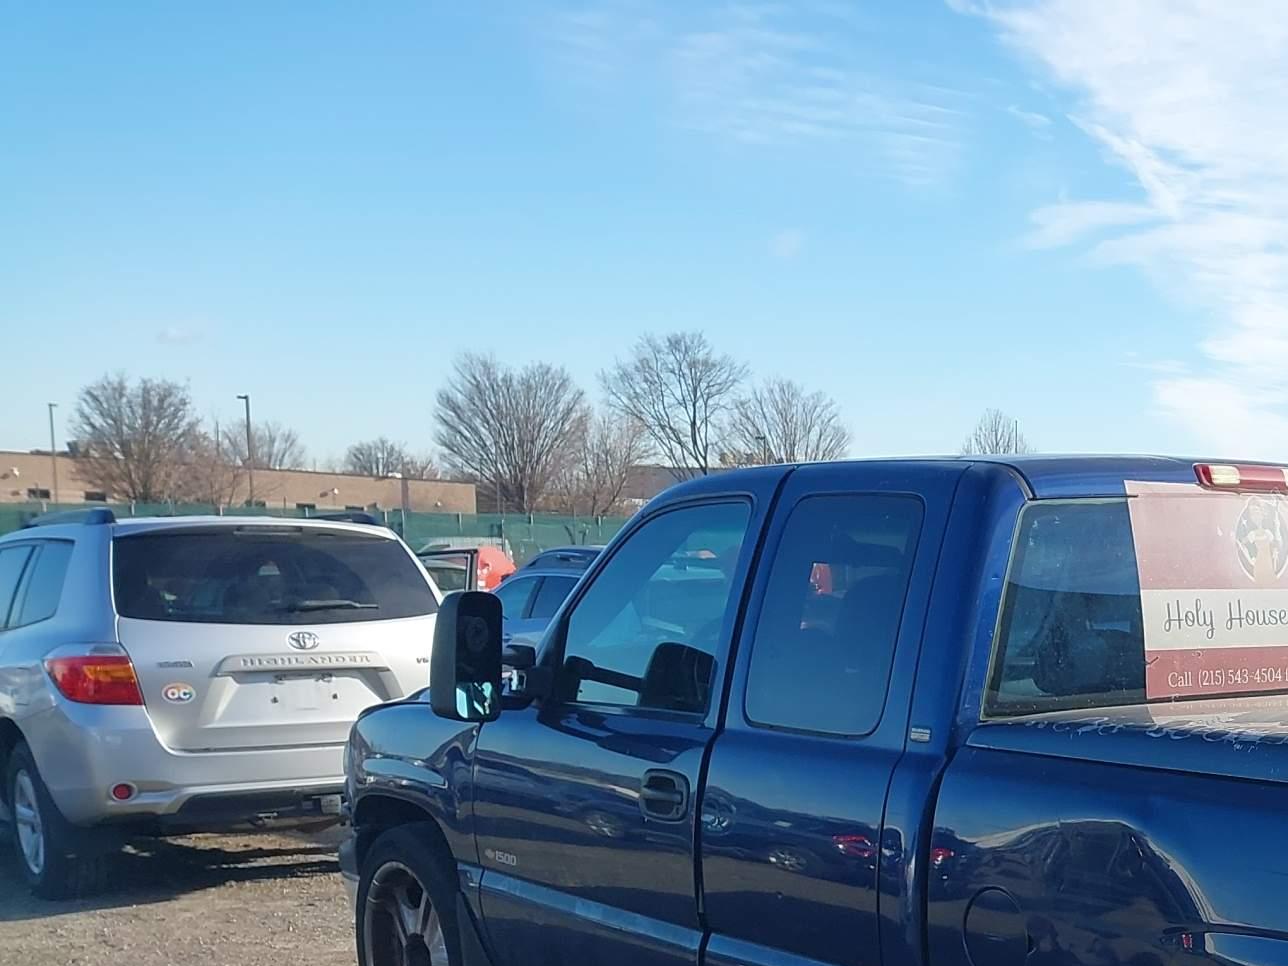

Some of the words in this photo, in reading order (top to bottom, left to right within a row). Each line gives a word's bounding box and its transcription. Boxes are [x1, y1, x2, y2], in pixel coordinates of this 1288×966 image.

[1163, 598, 1216, 639] Holy
[241, 655, 372, 667] HIGHLANDER
[1168, 671, 1193, 688] Call
[1198, 669, 1226, 688] (215)
[1227, 668, 1283, 685] 543-4504
[495, 850, 517, 866] 1500
